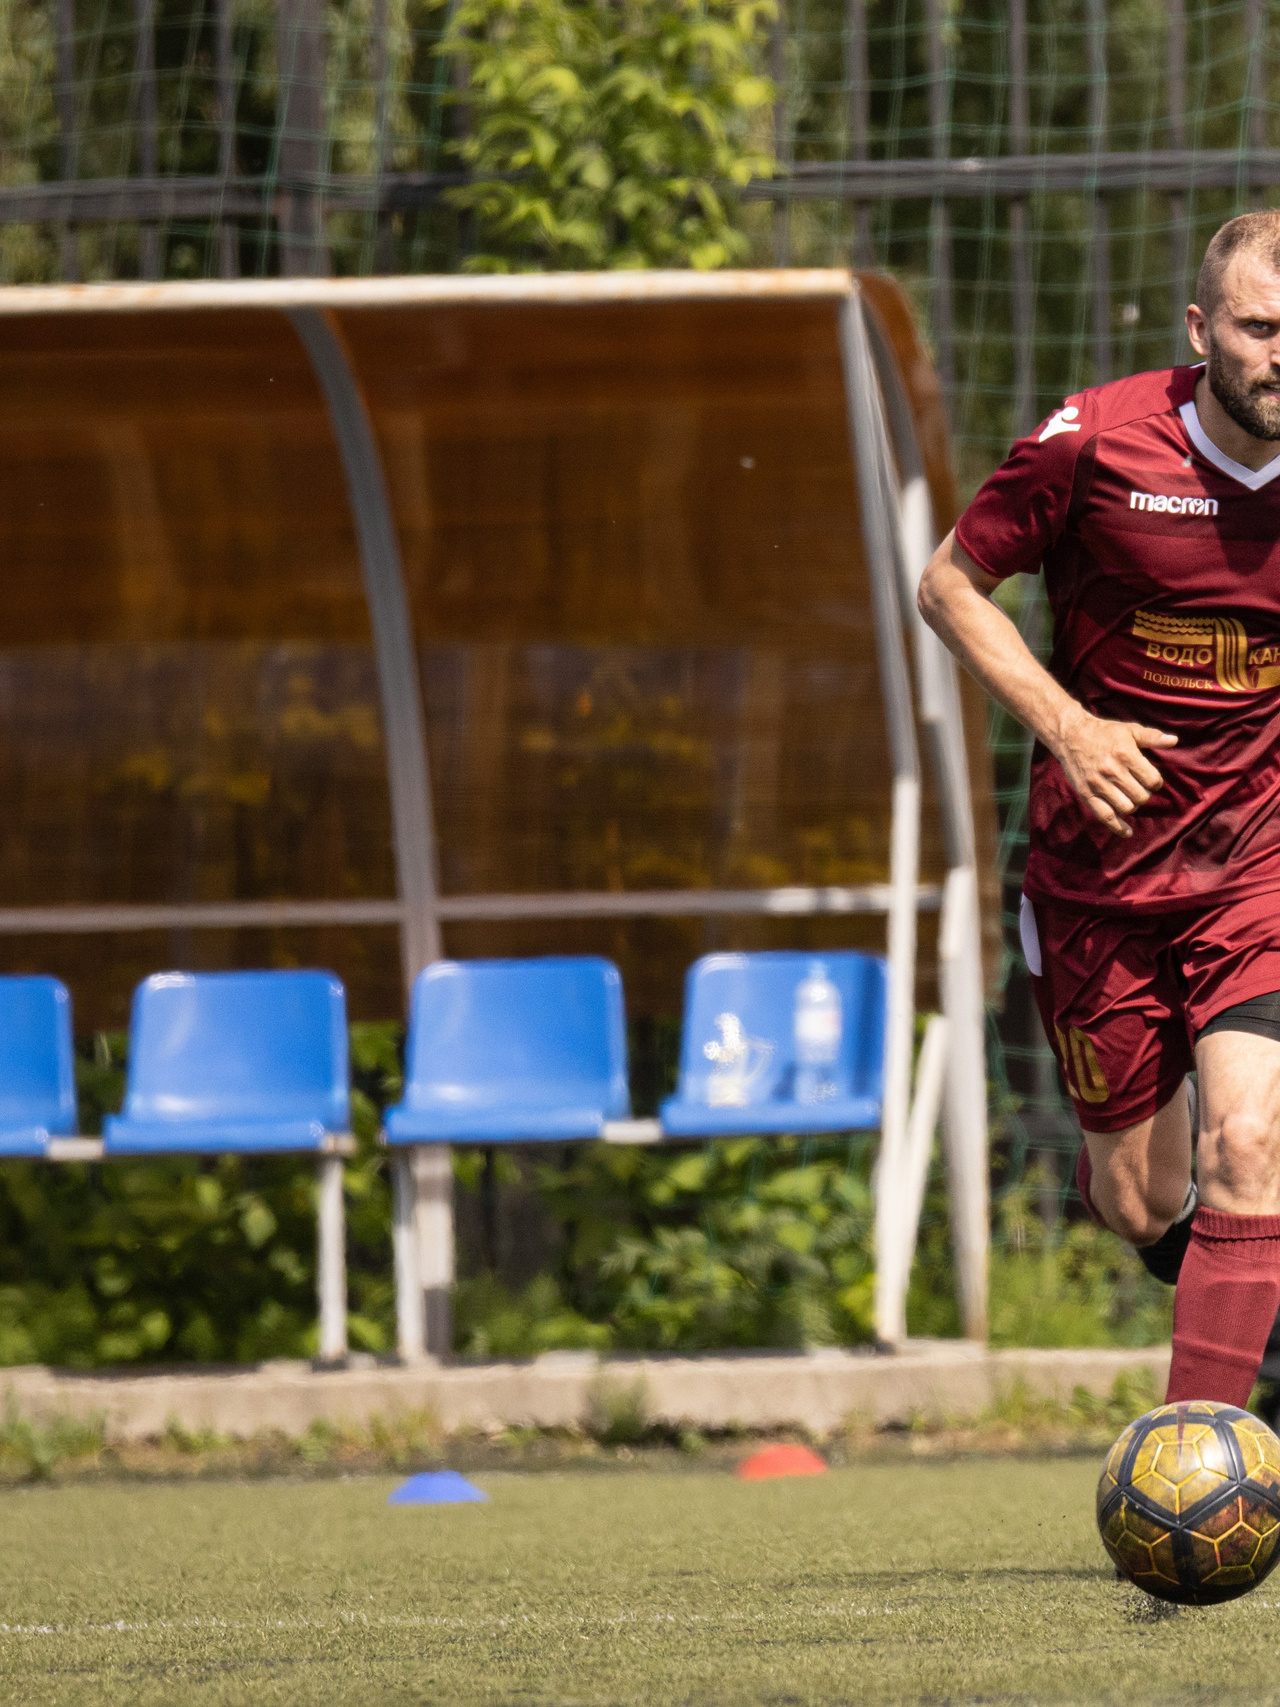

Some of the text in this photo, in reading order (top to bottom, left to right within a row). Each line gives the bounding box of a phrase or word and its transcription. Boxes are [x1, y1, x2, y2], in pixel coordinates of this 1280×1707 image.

[1130, 491, 1219, 516] macron
[1146, 642, 1213, 667] ВОДО
[1143, 670, 1214, 690] ПОДОЛЬСК
